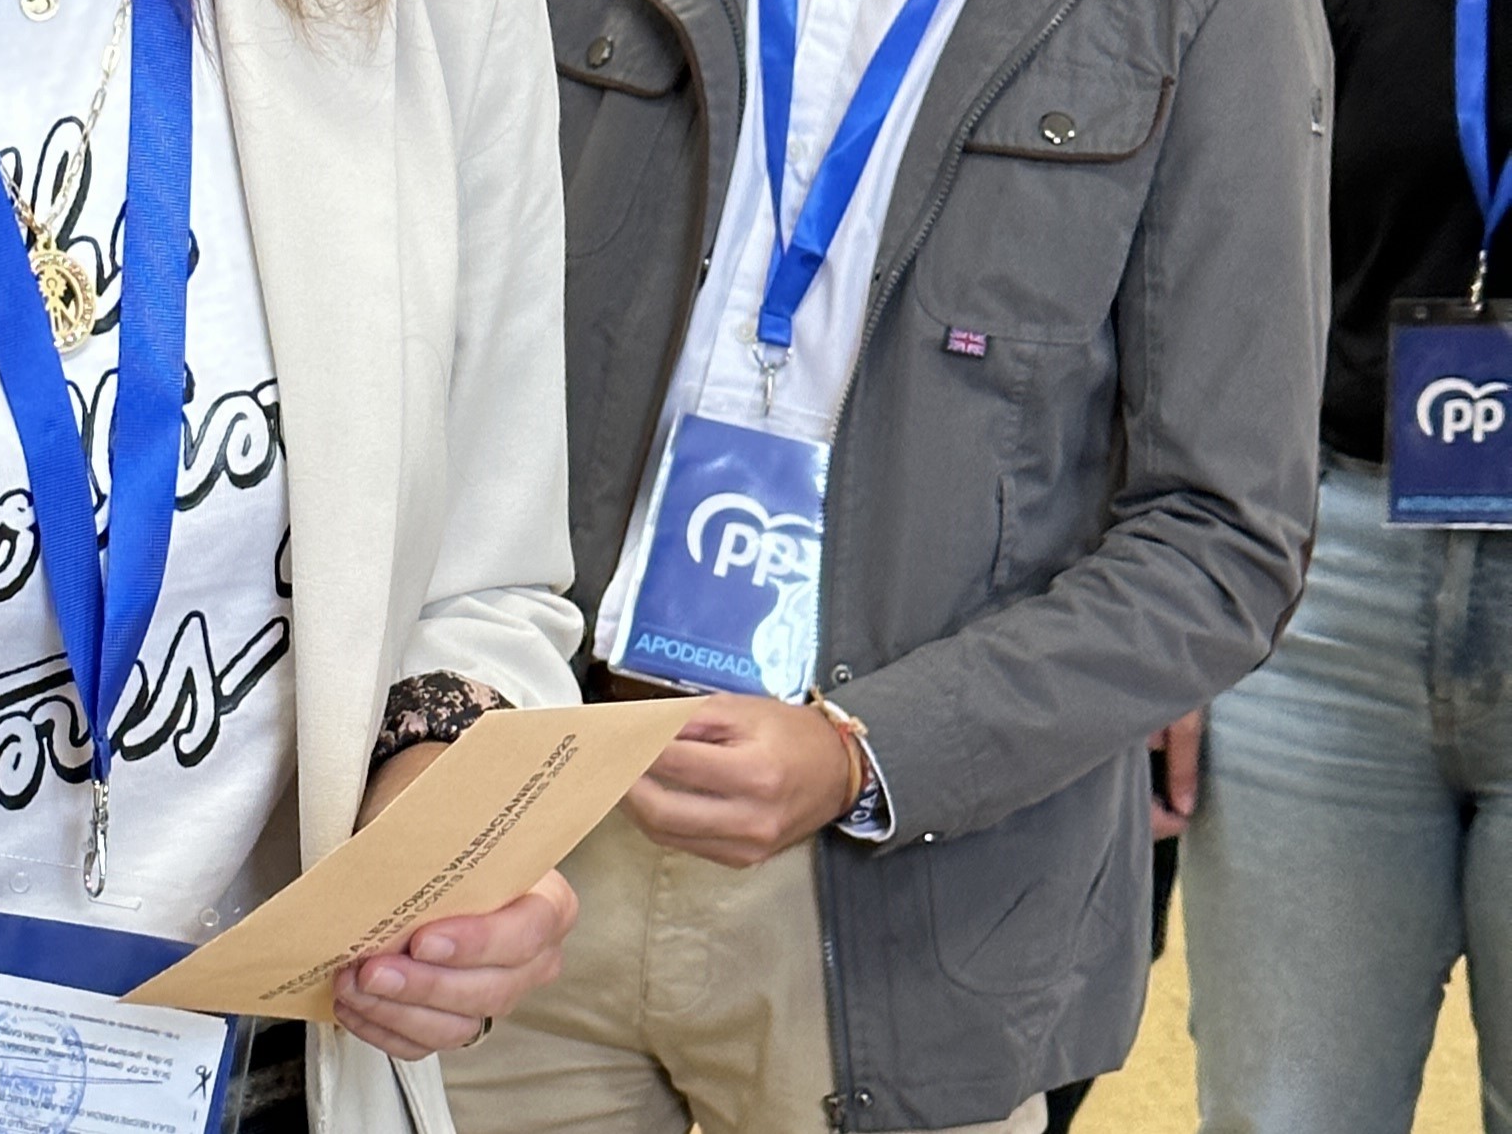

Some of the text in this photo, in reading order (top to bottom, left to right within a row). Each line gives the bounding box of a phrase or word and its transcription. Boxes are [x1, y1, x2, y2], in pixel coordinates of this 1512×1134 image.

[392, 872, 448, 917] CORTS
[442, 770, 546, 874] VALENCIANES
[542, 732, 577, 769] 2023
